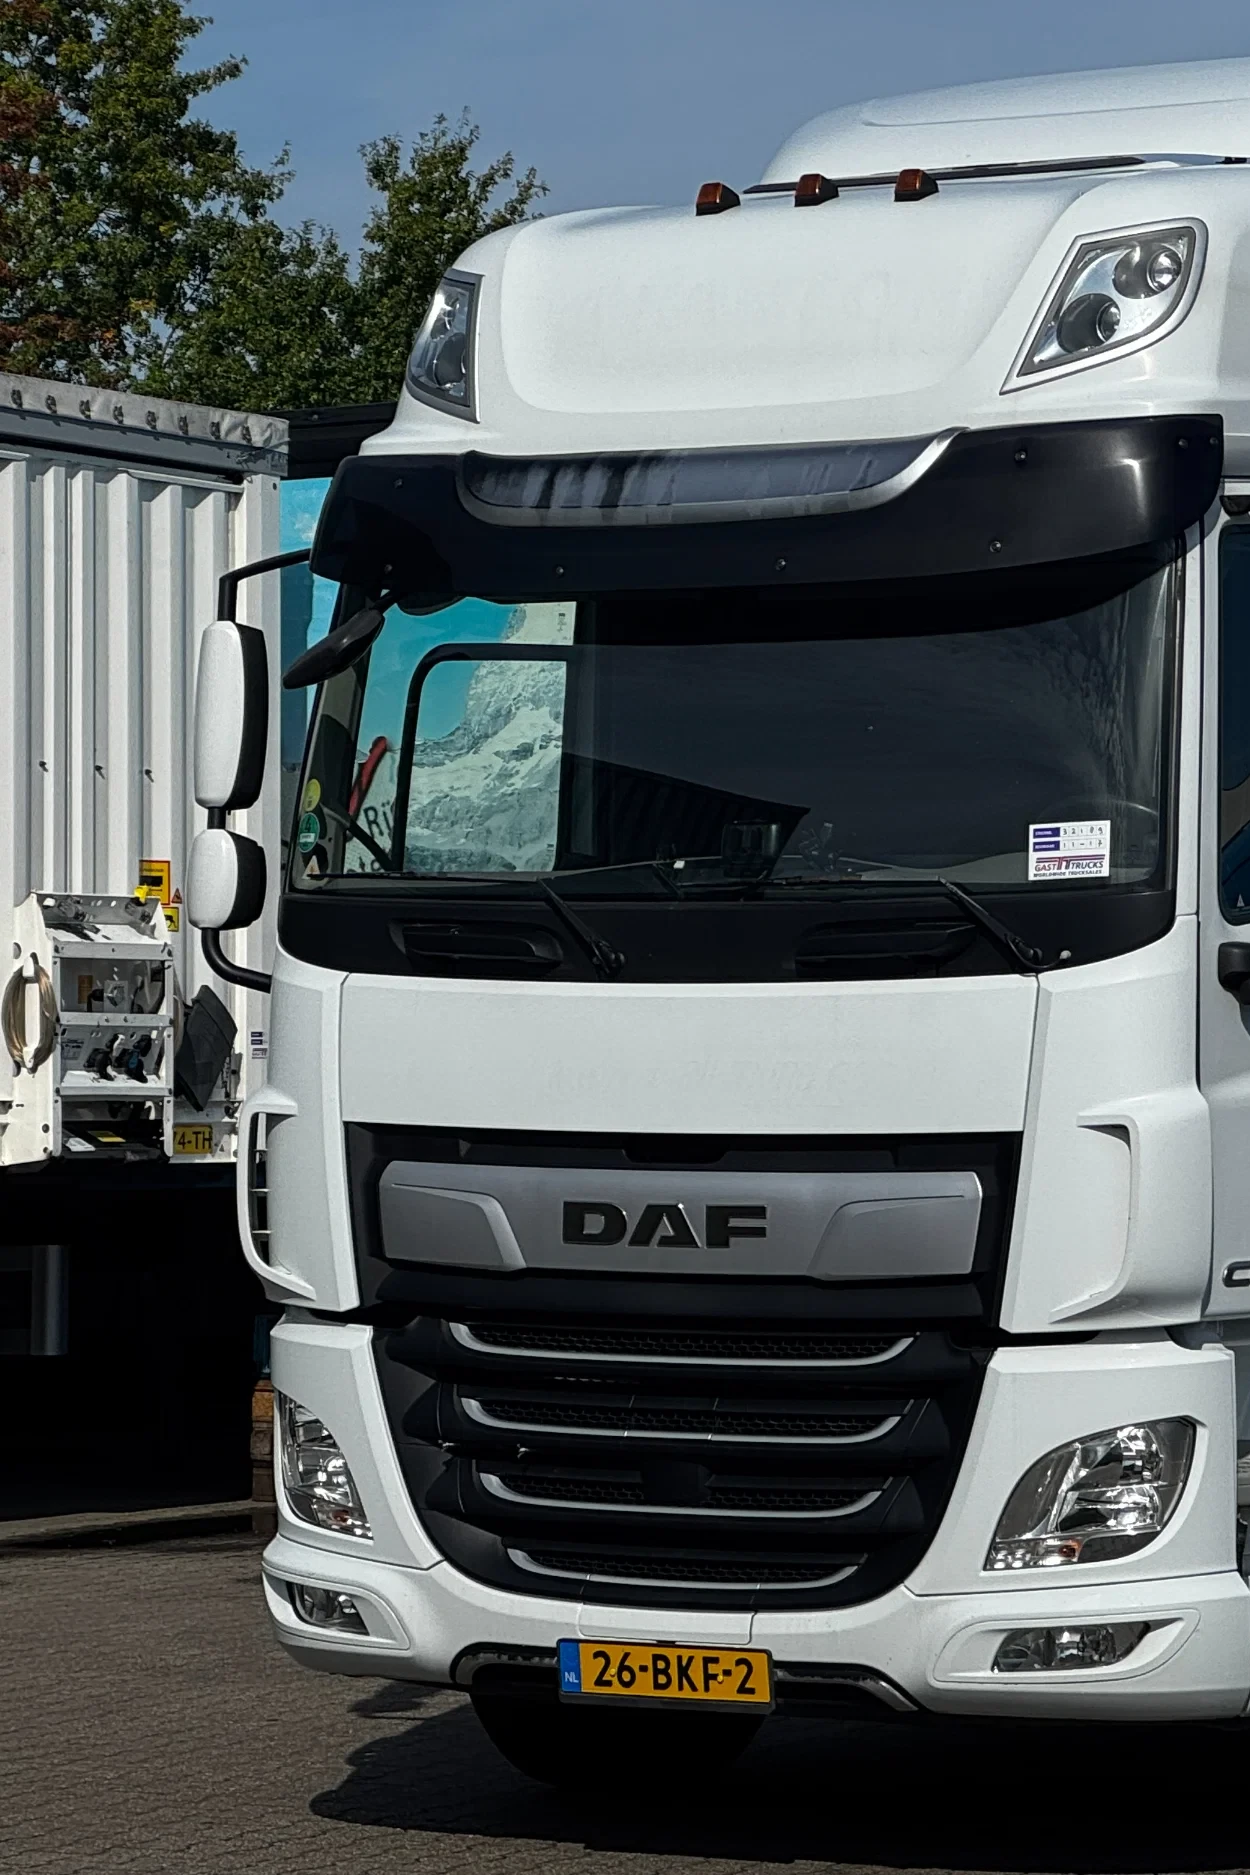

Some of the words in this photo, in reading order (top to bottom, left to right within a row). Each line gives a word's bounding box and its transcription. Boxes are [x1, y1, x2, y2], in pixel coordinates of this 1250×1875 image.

[562, 1201, 767, 1249] DAF
[564, 1671, 579, 1683] NL
[592, 1650, 756, 1695] 26-BKF-2
